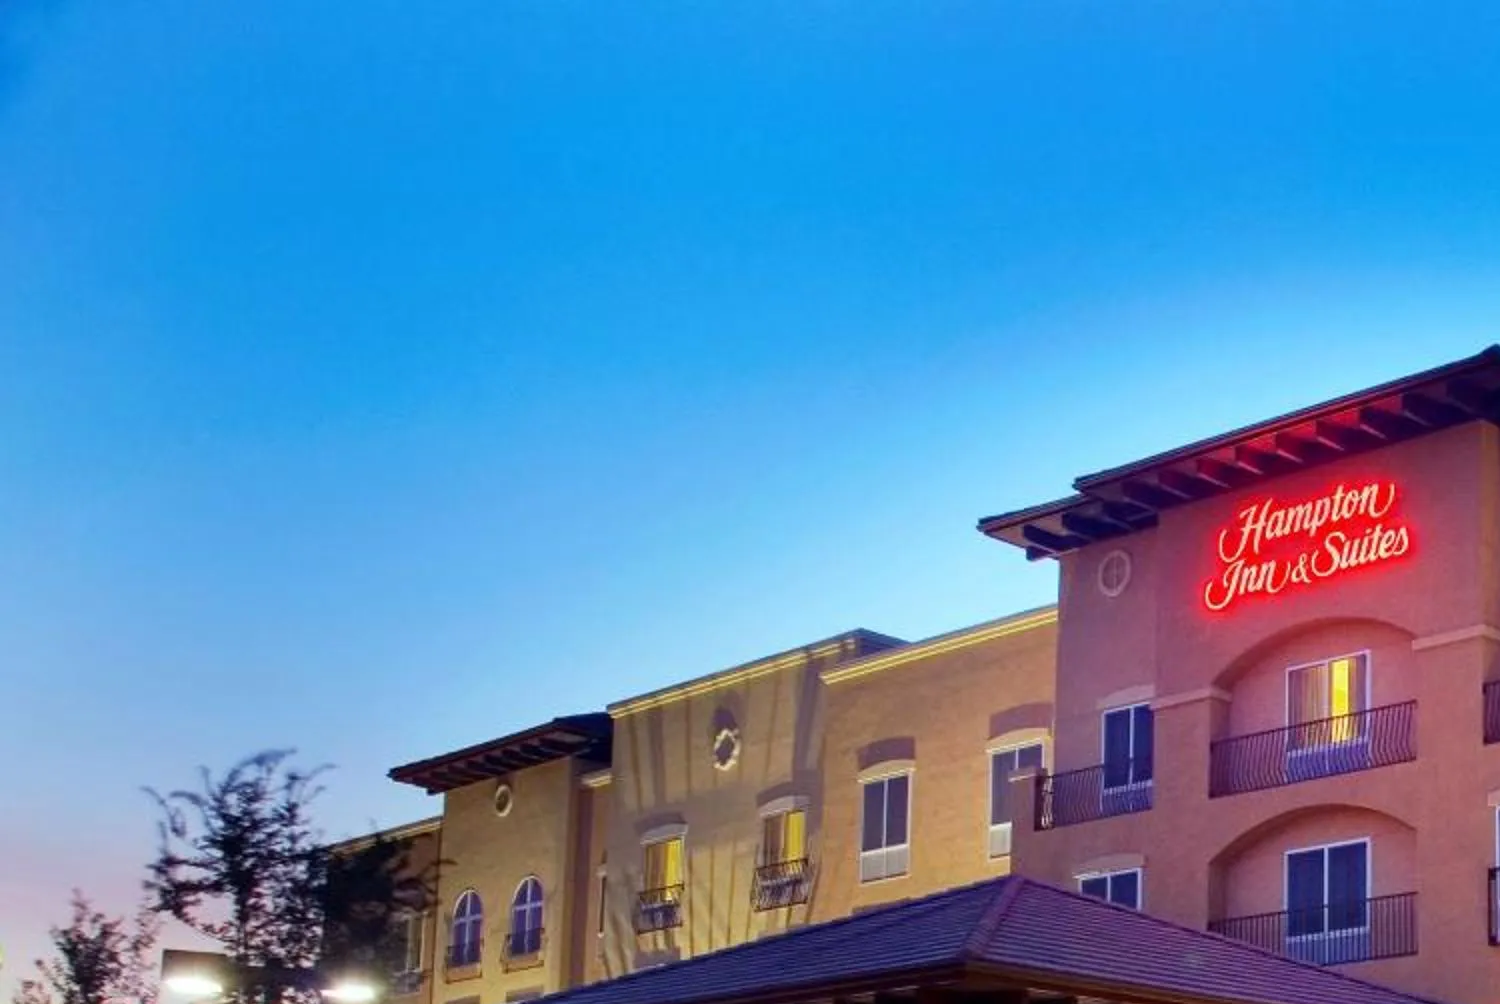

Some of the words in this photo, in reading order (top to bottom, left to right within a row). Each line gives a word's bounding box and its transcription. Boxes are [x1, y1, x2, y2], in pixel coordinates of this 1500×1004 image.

[1218, 483, 1396, 563] Hampton
[1203, 557, 1291, 611] Inn
[1291, 553, 1312, 584] &
[1311, 523, 1409, 578] Suites
